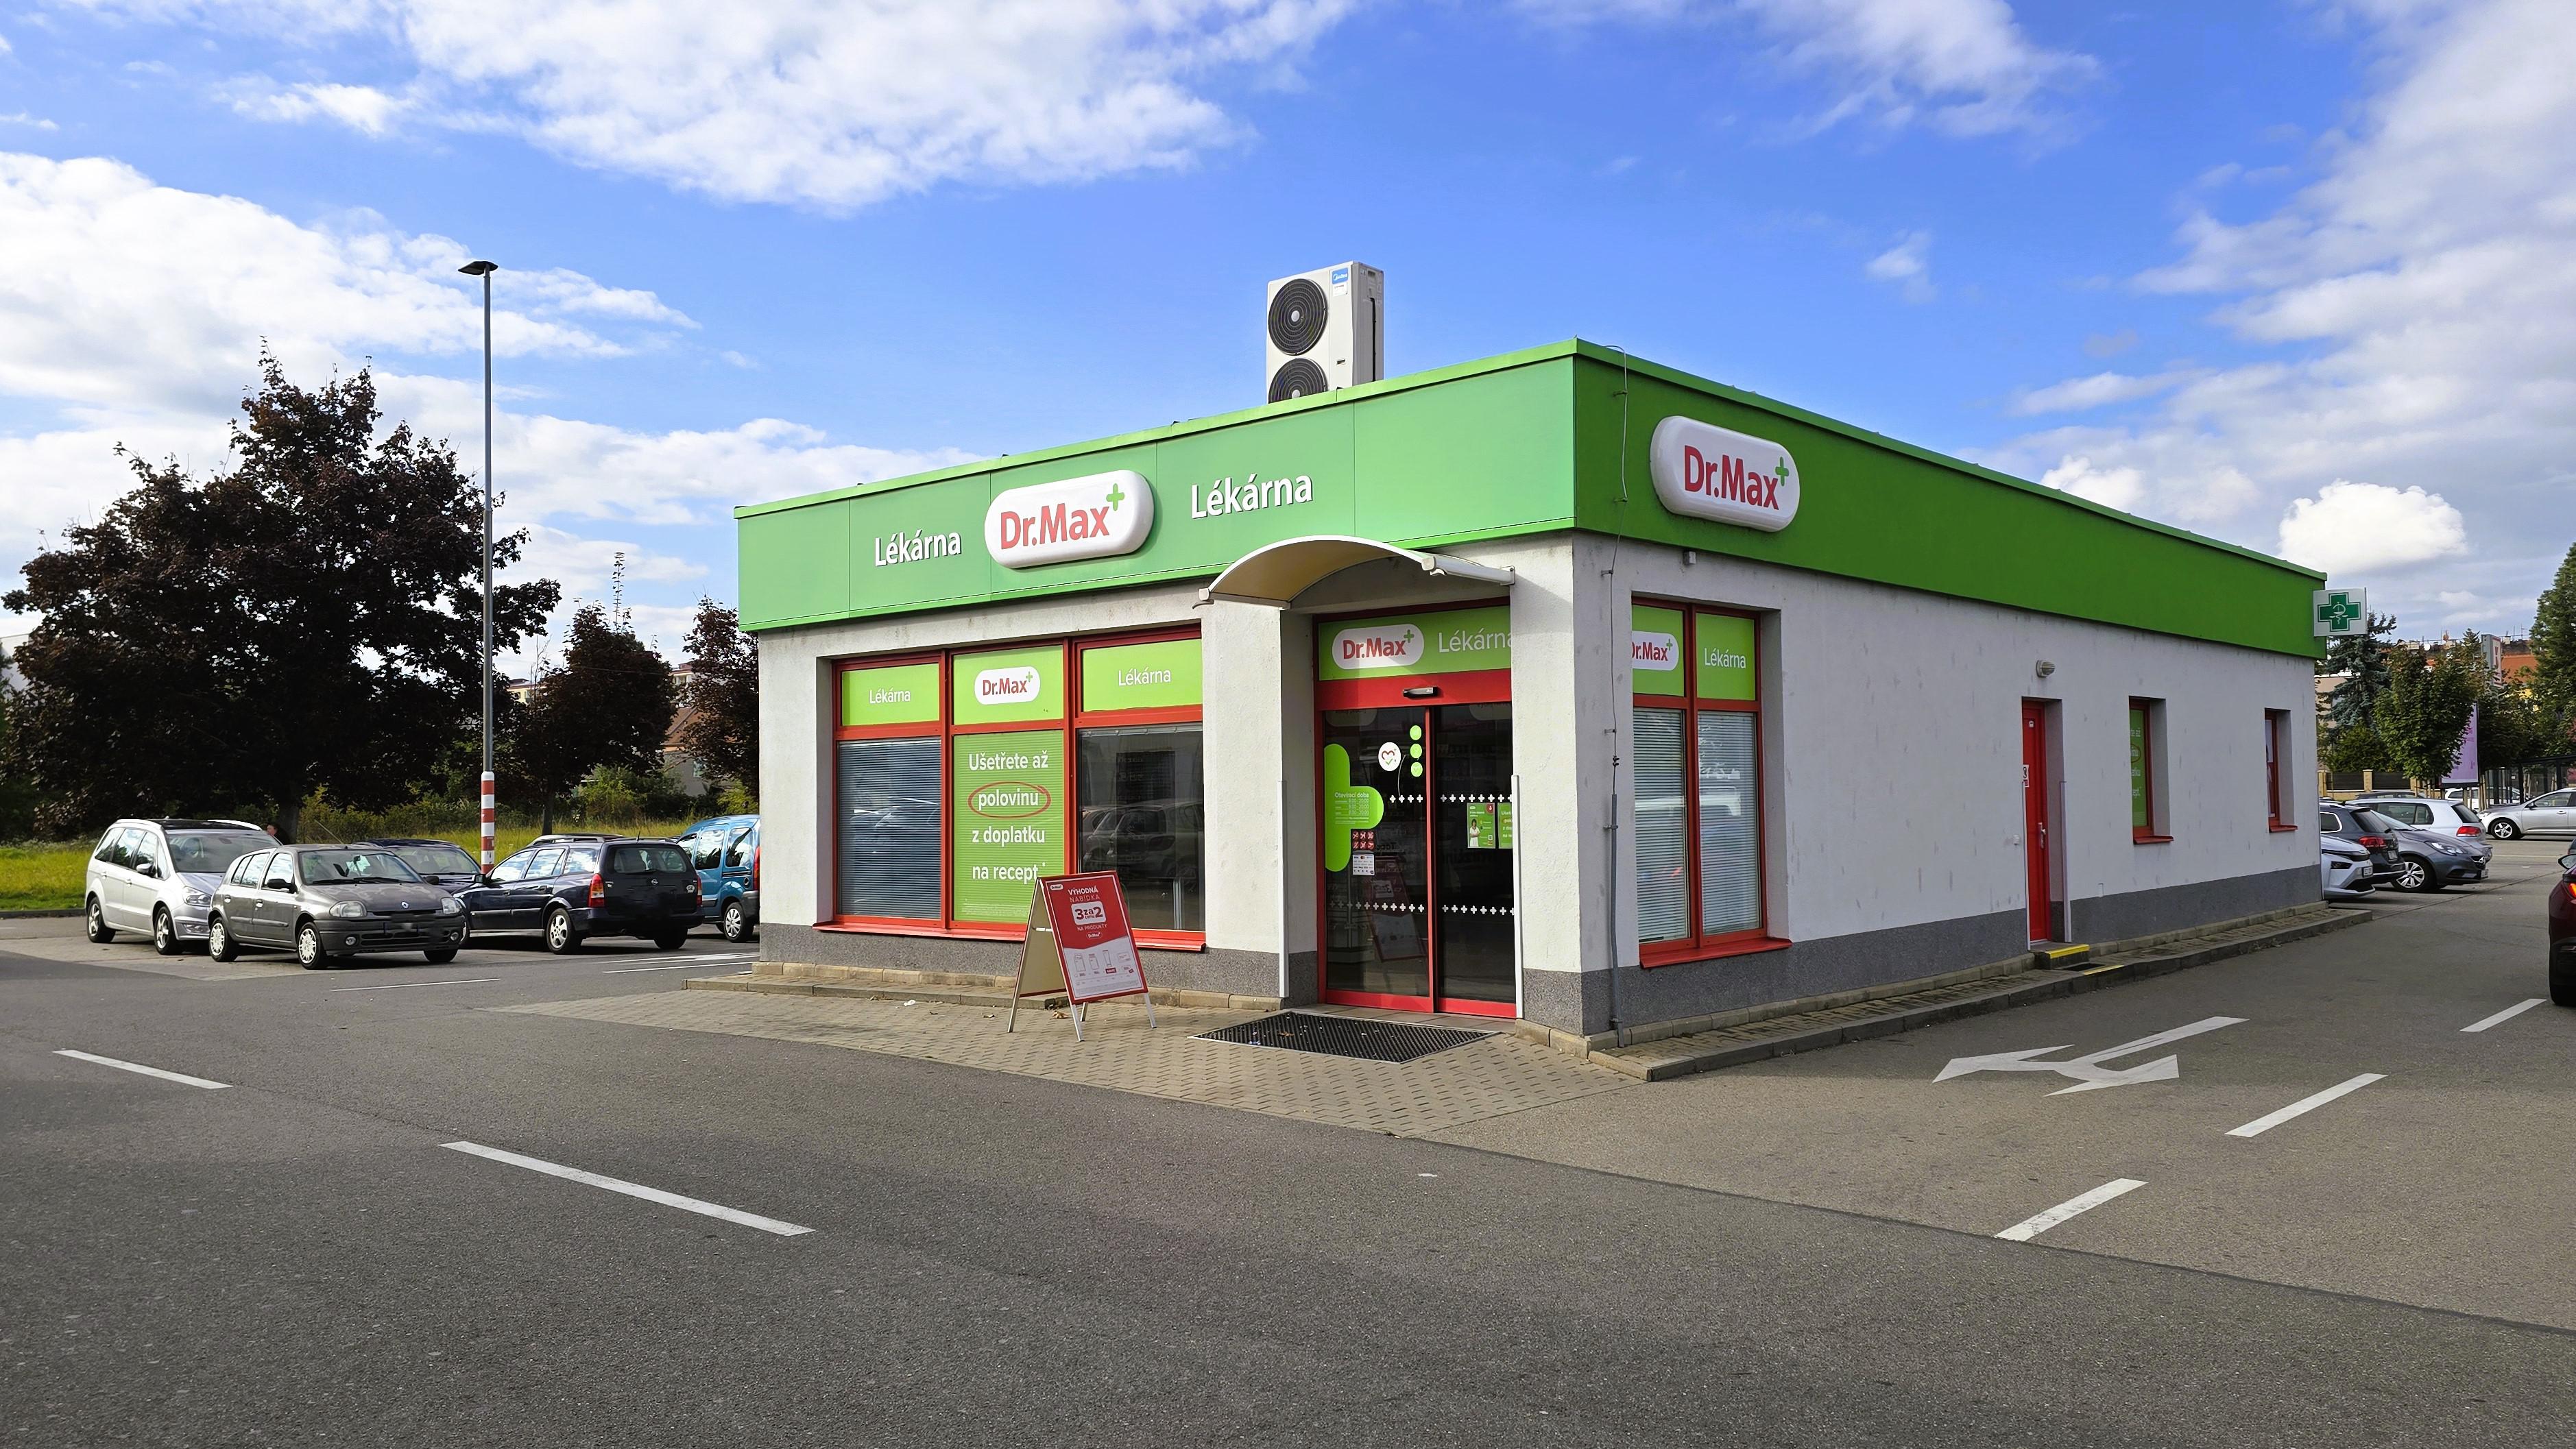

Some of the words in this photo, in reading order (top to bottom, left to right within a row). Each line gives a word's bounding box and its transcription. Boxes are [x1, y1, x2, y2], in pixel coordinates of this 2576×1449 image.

[1684, 444, 1779, 511] Dr.Max
[1191, 473, 1313, 520] Lékárna
[1000, 502, 1109, 550] Dr.Max
[874, 530, 961, 567] Lékárna
[1343, 637, 1406, 659] Dr.Max
[1704, 647, 1747, 670] Lékárna
[982, 677, 1028, 696] Dr.Max
[1118, 667, 1172, 687] Lékárna
[869, 687, 911, 705] Lékárna
[968, 751, 1028, 771] Ušetřete
[1032, 750, 1048, 769] až
[978, 788, 1039, 811] polovinu
[972, 829, 980, 843] z
[983, 825, 1046, 847] doplatku
[972, 866, 989, 880] na
[1068, 886, 1098, 895] VÝHODNÁ
[1075, 908, 1085, 920] 3
[1093, 906, 1103, 918] 2
